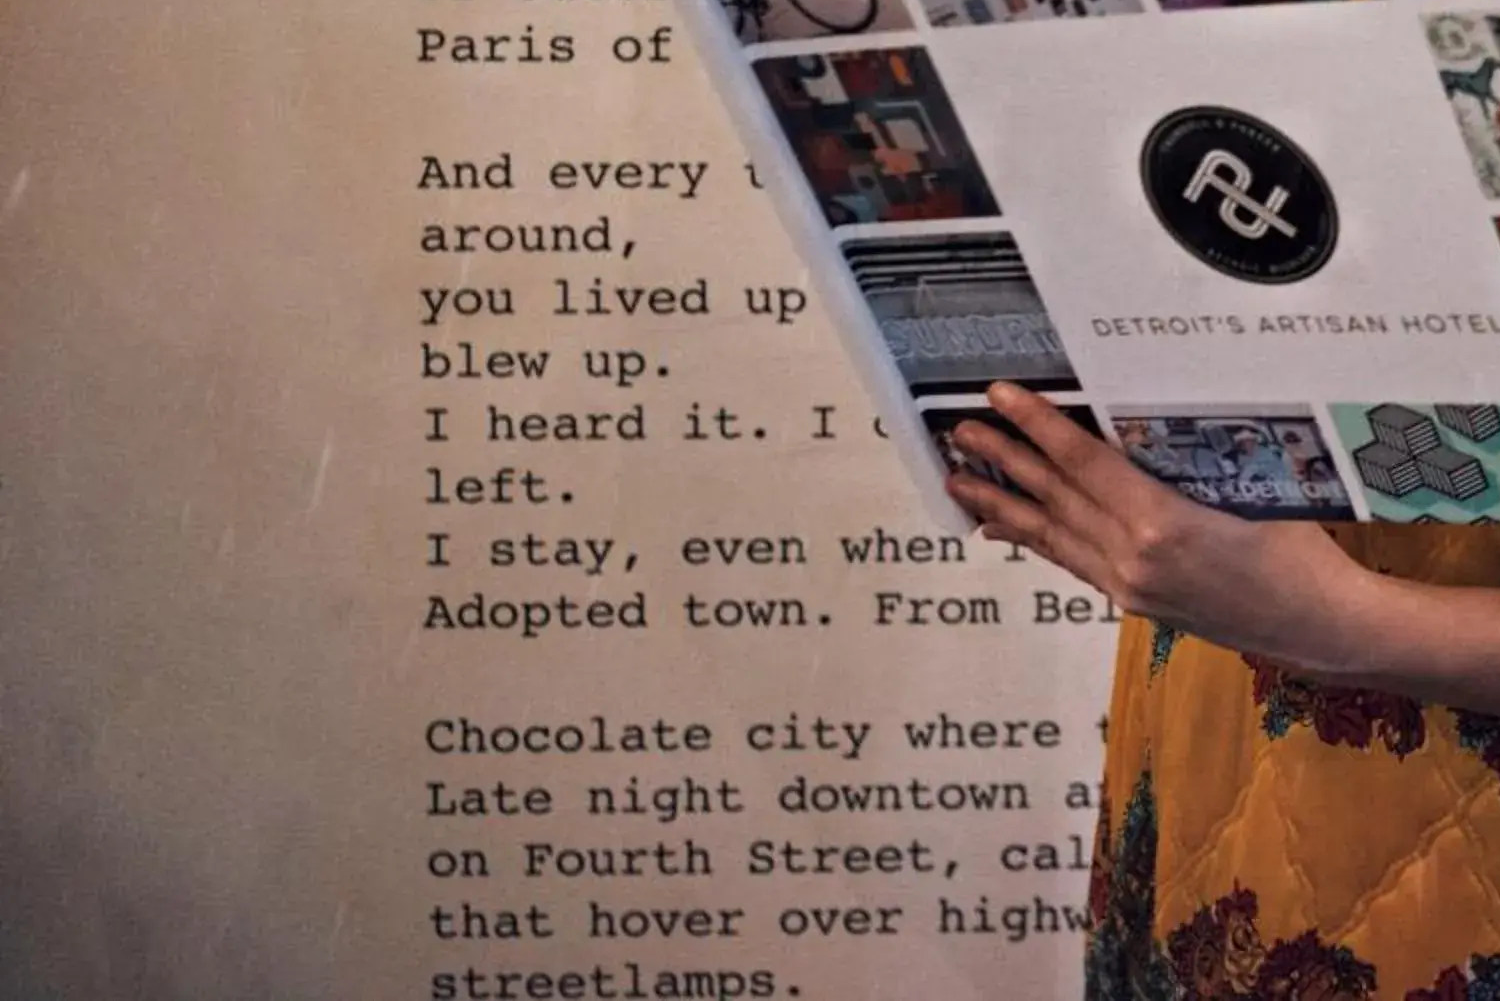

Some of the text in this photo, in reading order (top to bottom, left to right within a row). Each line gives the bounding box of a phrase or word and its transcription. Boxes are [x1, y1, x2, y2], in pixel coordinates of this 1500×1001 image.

[416, 24, 672, 64] Paris of
[417, 152, 515, 190] And
[549, 161, 709, 199] every
[420, 216, 636, 260] around,
[420, 277, 807, 326] you lived up
[1091, 316, 1247, 338] DETROIT'S
[1257, 313, 1388, 336] ARTISAN
[420, 342, 669, 388] blew up.
[425, 407, 449, 442] I
[488, 404, 646, 442] heard
[683, 402, 766, 440] it.
[812, 406, 836, 439] I
[426, 467, 573, 505] left.
[427, 533, 450, 567] I
[490, 533, 638, 576] stay,
[681, 536, 807, 566] even
[839, 527, 966, 564] when
[423, 591, 1117, 638] Adopted town. From Bel
[425, 716, 712, 754] Chocolate
[746, 712, 871, 760] city
[904, 712, 1061, 749] where
[426, 781, 552, 816] Late
[588, 776, 744, 823] night
[778, 776, 1030, 813] downtown
[428, 839, 958, 879] on Fourth Street,
[430, 896, 1092, 943] that hover over highw
